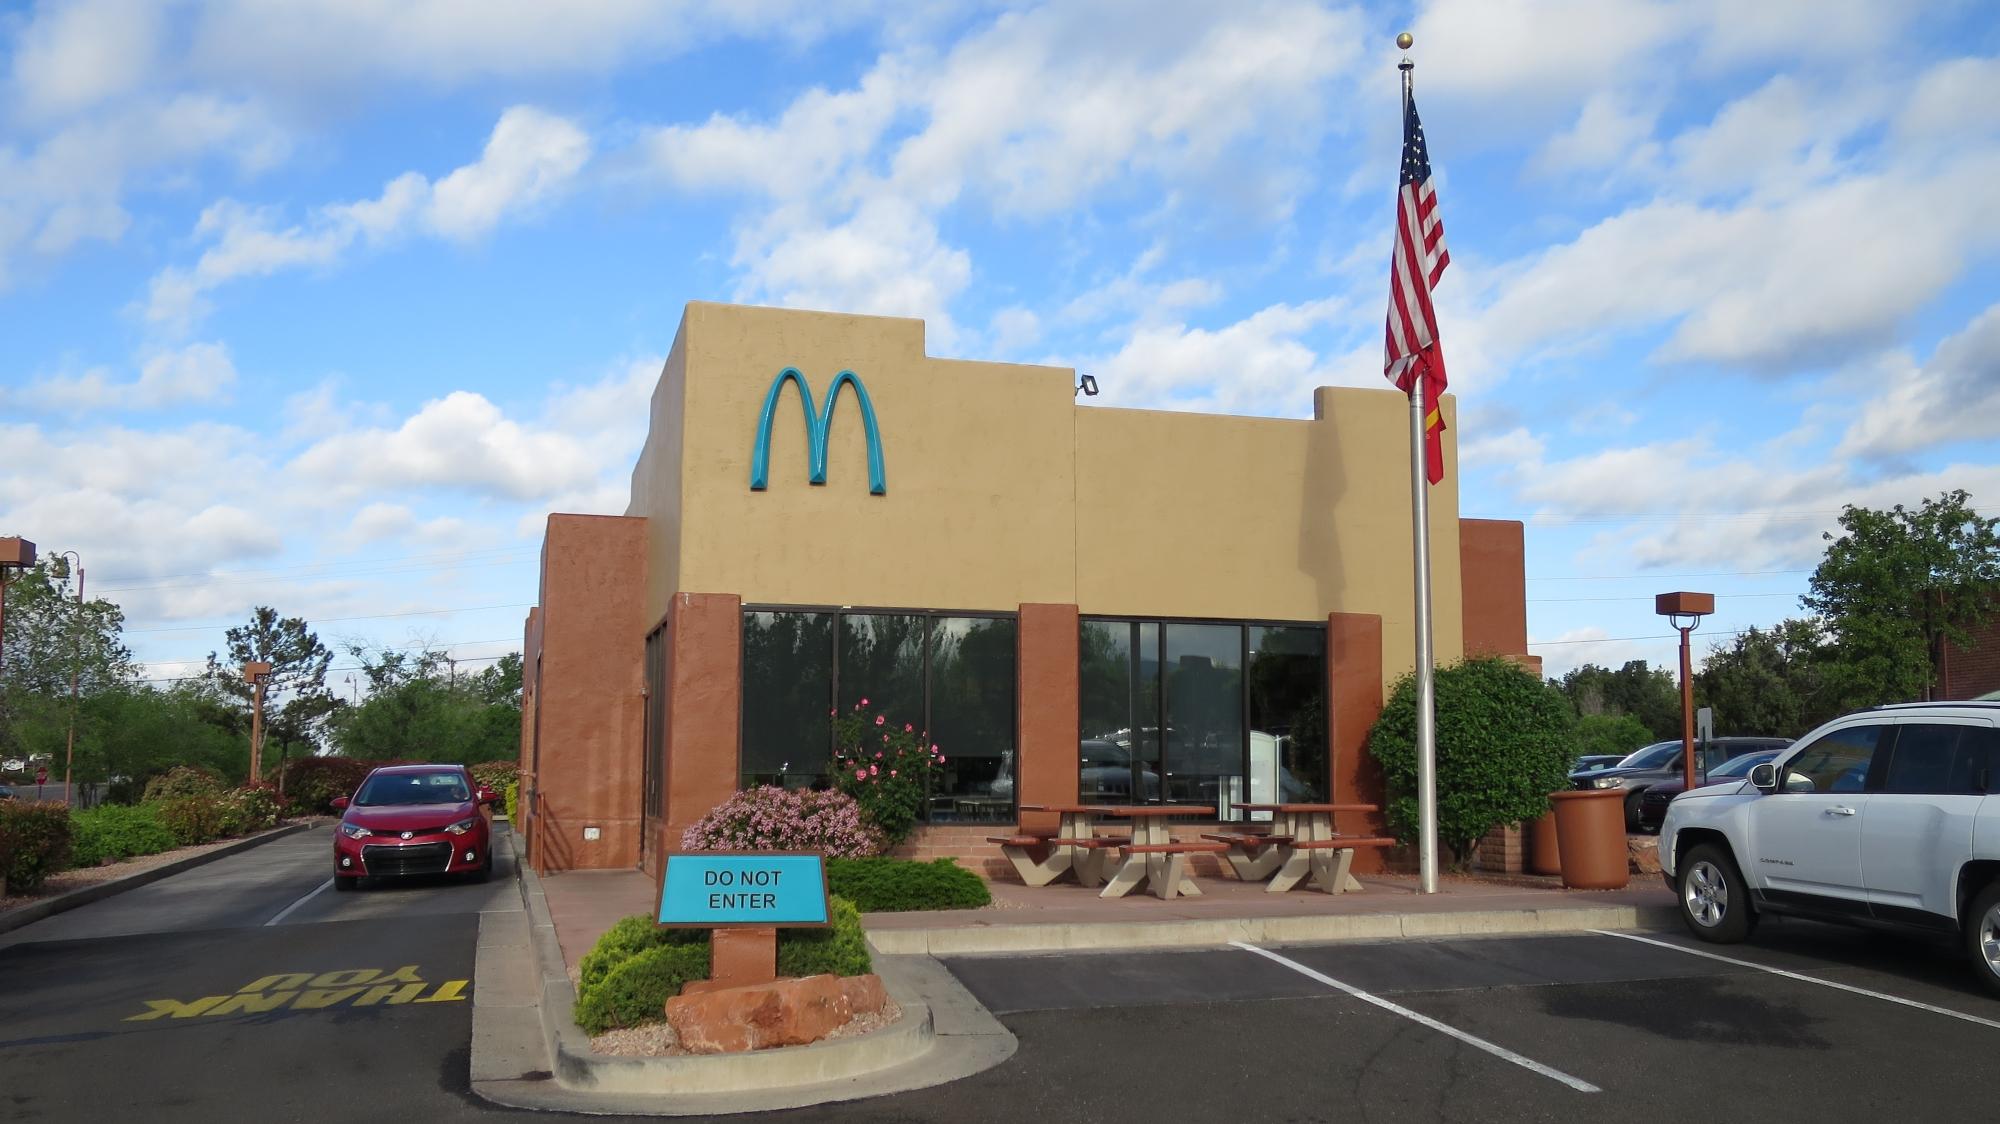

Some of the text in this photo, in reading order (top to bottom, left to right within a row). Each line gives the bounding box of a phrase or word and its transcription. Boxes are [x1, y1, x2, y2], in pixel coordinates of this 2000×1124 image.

[750, 366, 886, 496] M
[704, 870, 782, 886] DO NOT
[709, 893, 776, 909] ENTER
[237, 965, 423, 993] YOU
[120, 979, 470, 1021] THANK
